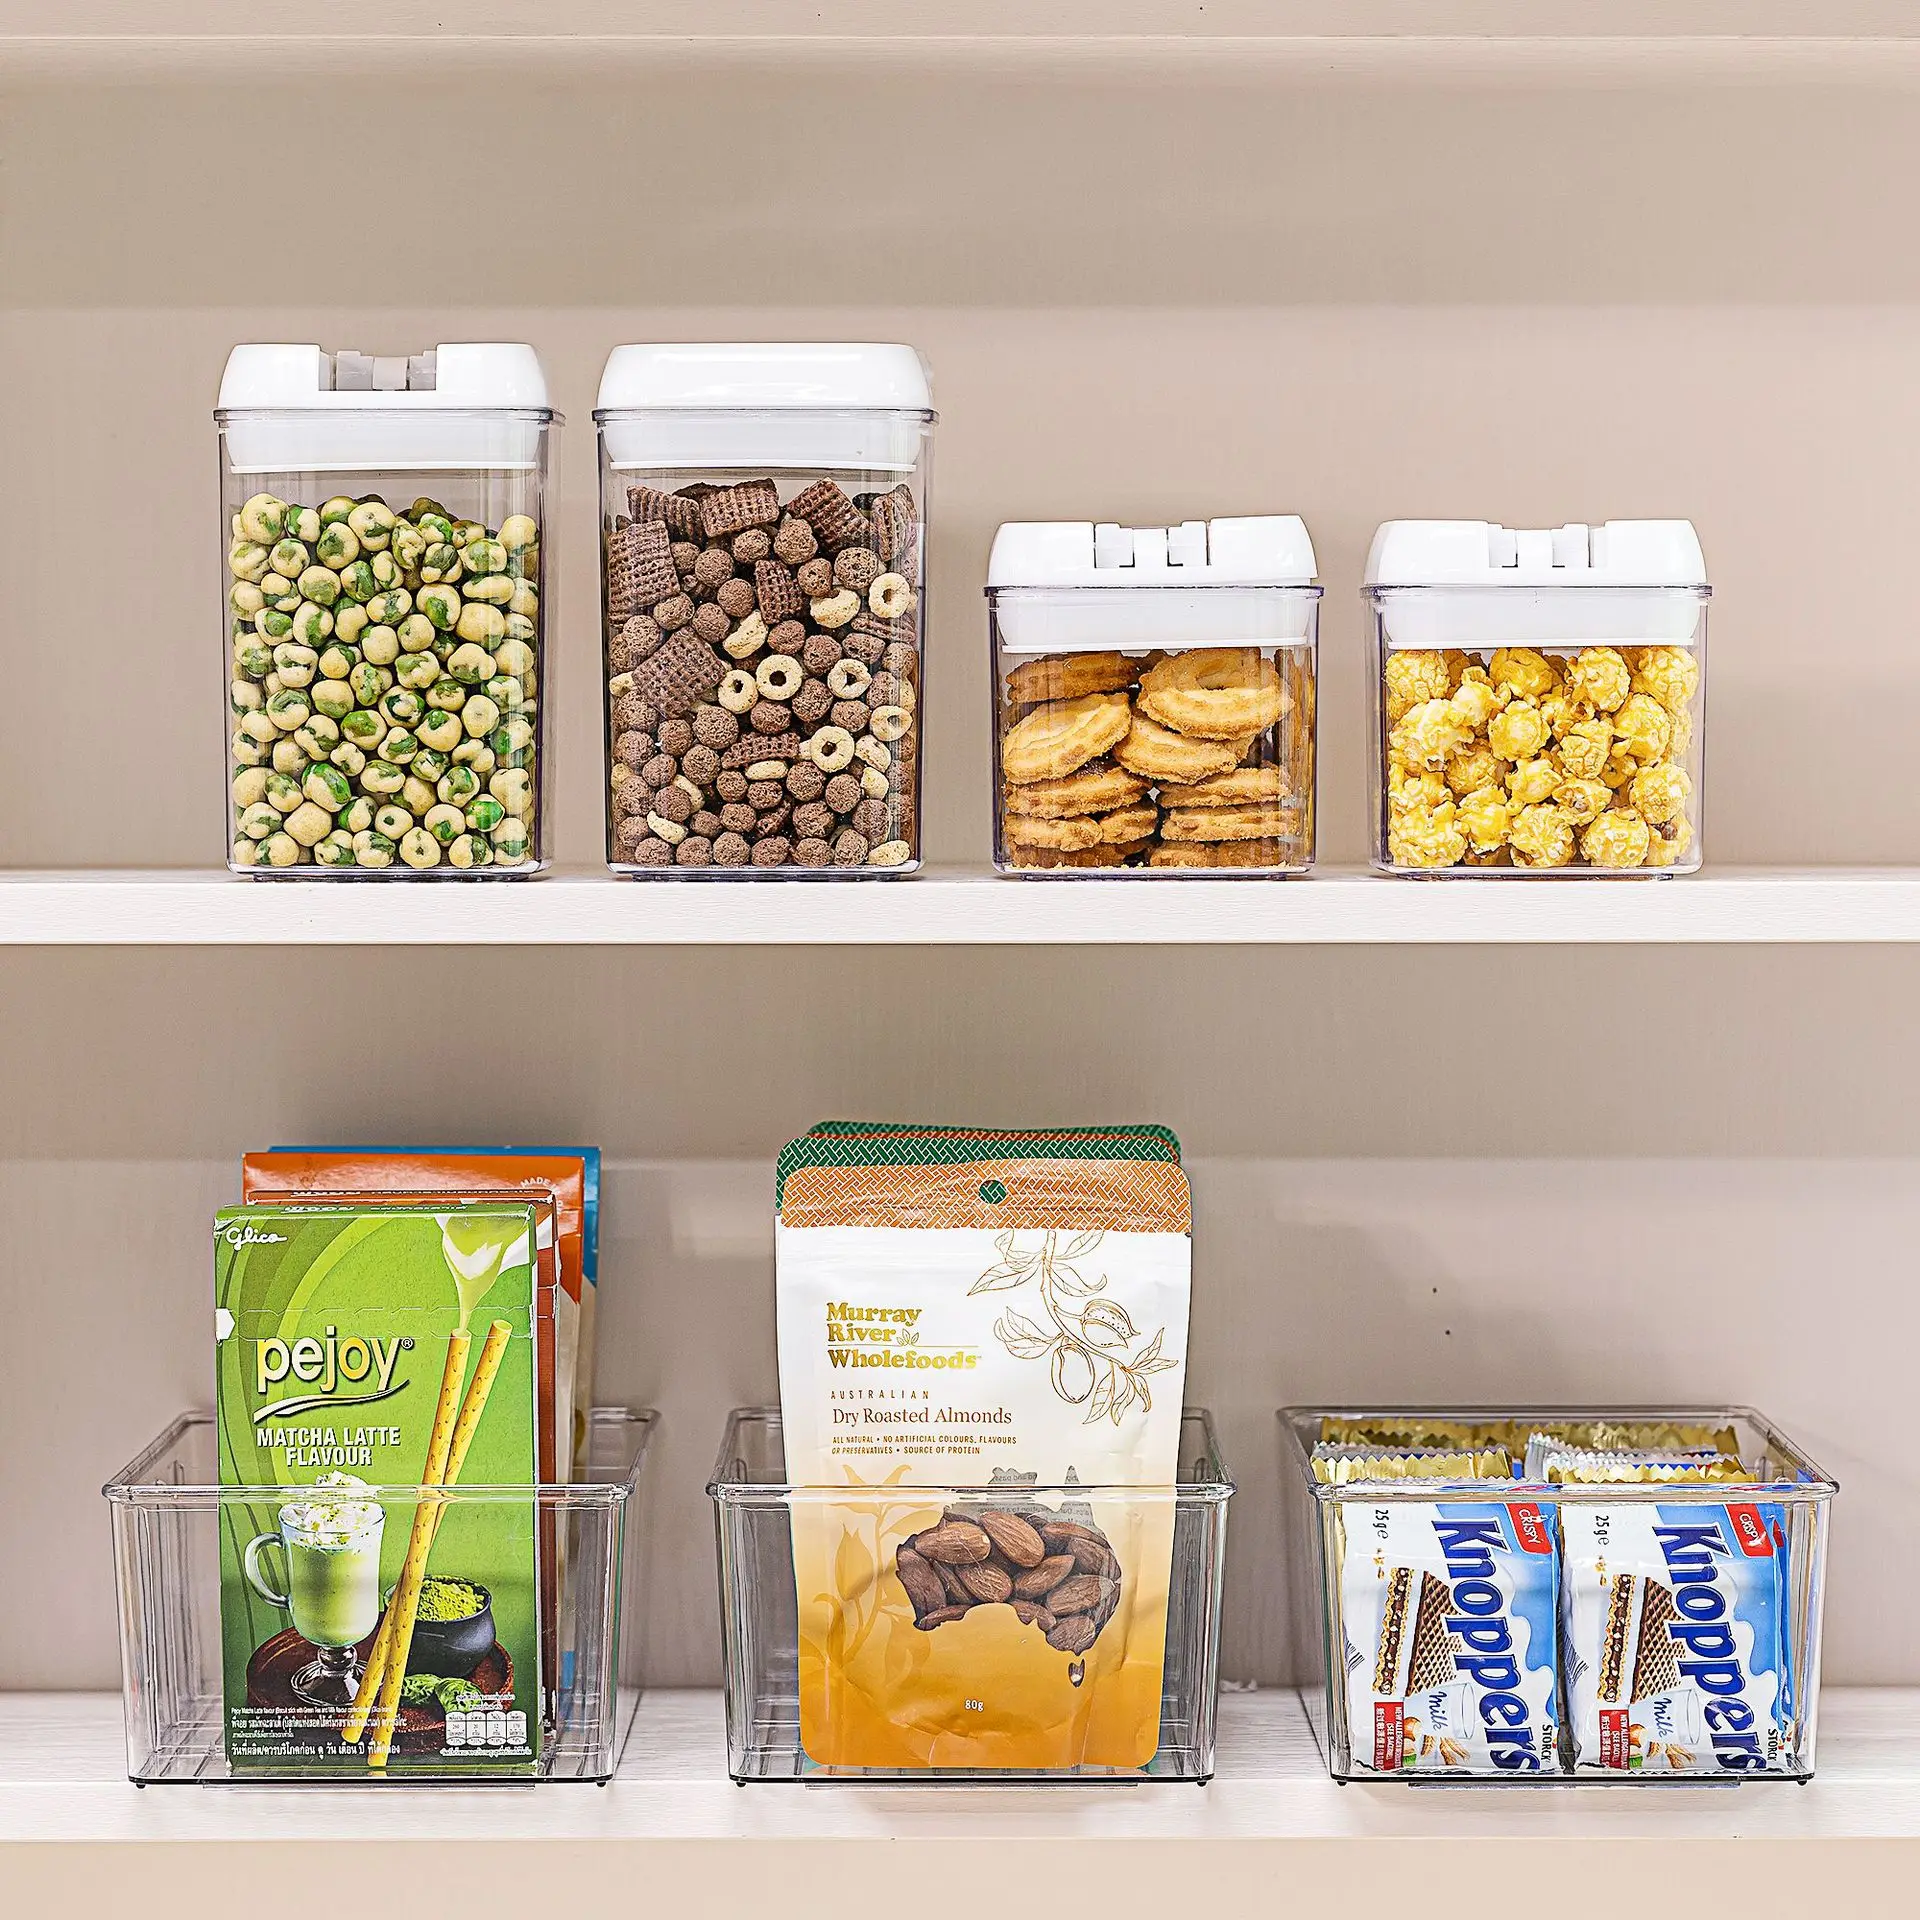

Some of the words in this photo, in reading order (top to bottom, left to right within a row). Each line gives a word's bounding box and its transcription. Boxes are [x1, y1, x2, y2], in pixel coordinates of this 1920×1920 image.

[520, 1177, 552, 1188] MADE
[226, 1227, 287, 1249] Glico
[826, 1302, 922, 1326] Murray
[828, 1323, 897, 1342] River
[256, 1325, 400, 1394] pejoy
[827, 1349, 978, 1370] Wholefoods
[831, 1390, 929, 1399] AUSTRALIAN
[832, 1408, 859, 1427] Dry
[863, 1407, 929, 1424] Roasted
[934, 1407, 1012, 1424] Almonds
[257, 1428, 337, 1447] MATCHA
[343, 1427, 401, 1447] LATTE
[832, 1436, 844, 1444] ALL
[846, 1436, 874, 1444] NATURAL
[882, 1435, 893, 1443] NO
[895, 1435, 936, 1443] ARTIFICIAL
[979, 1436, 1017, 1445] FLAVOURS
[286, 1447, 373, 1467] FLAVOUR
[831, 1447, 841, 1455] OR
[842, 1446, 893, 1455] PRESERVATIVES
[903, 1446, 933, 1454] SOURCE
[935, 1446, 945, 1454] OF
[1518, 1509, 1543, 1544] CRISPY
[1739, 1513, 1765, 1546] CRISPY
[1432, 1519, 1540, 1769] Knoppers
[1652, 1525, 1768, 1769] Knoppers
[965, 1699, 984, 1712] 80g
[1541, 1724, 1553, 1762] STORCK
[1767, 1728, 1778, 1762] STORCK
